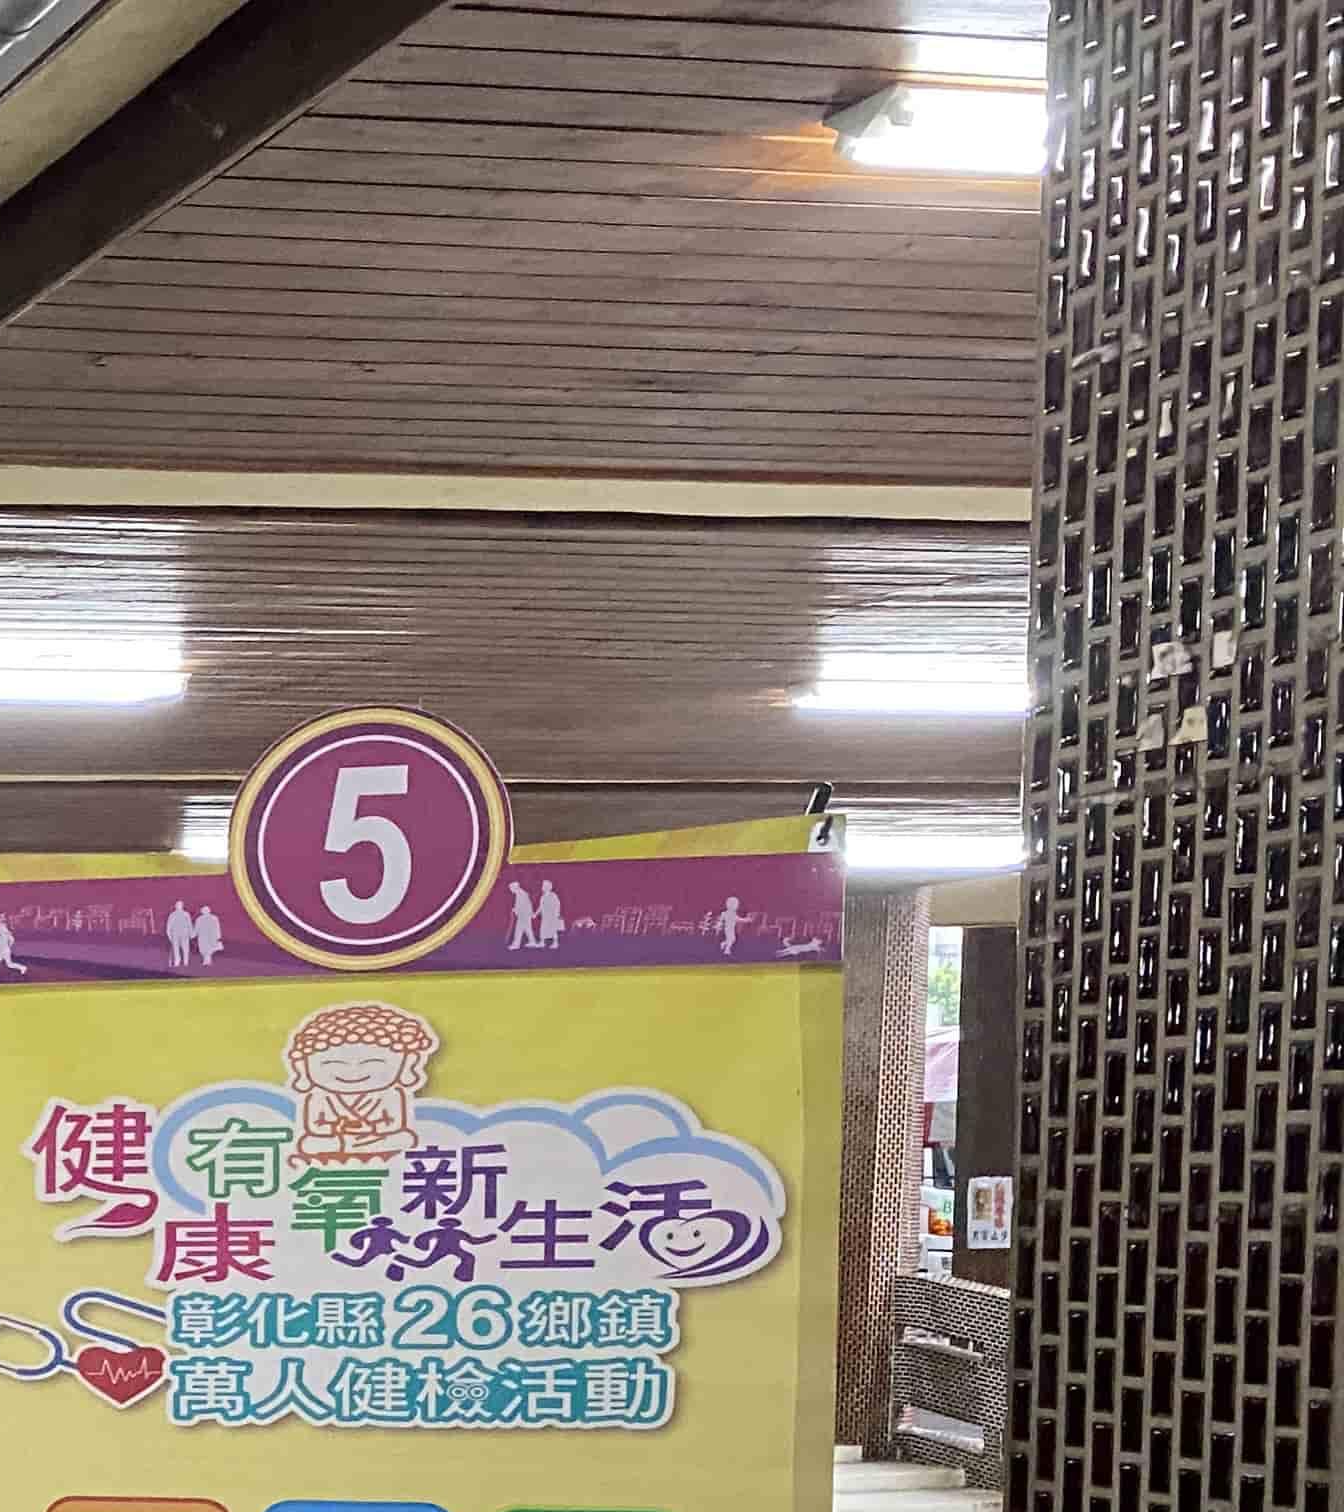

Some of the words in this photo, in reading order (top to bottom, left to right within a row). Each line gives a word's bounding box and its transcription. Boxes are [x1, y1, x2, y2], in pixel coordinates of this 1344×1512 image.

[320, 764, 412, 925] 5
[176, 1286, 668, 1349] 彰化縣26鄉鎮
[174, 1357, 665, 1421] 萬人健檢活動
